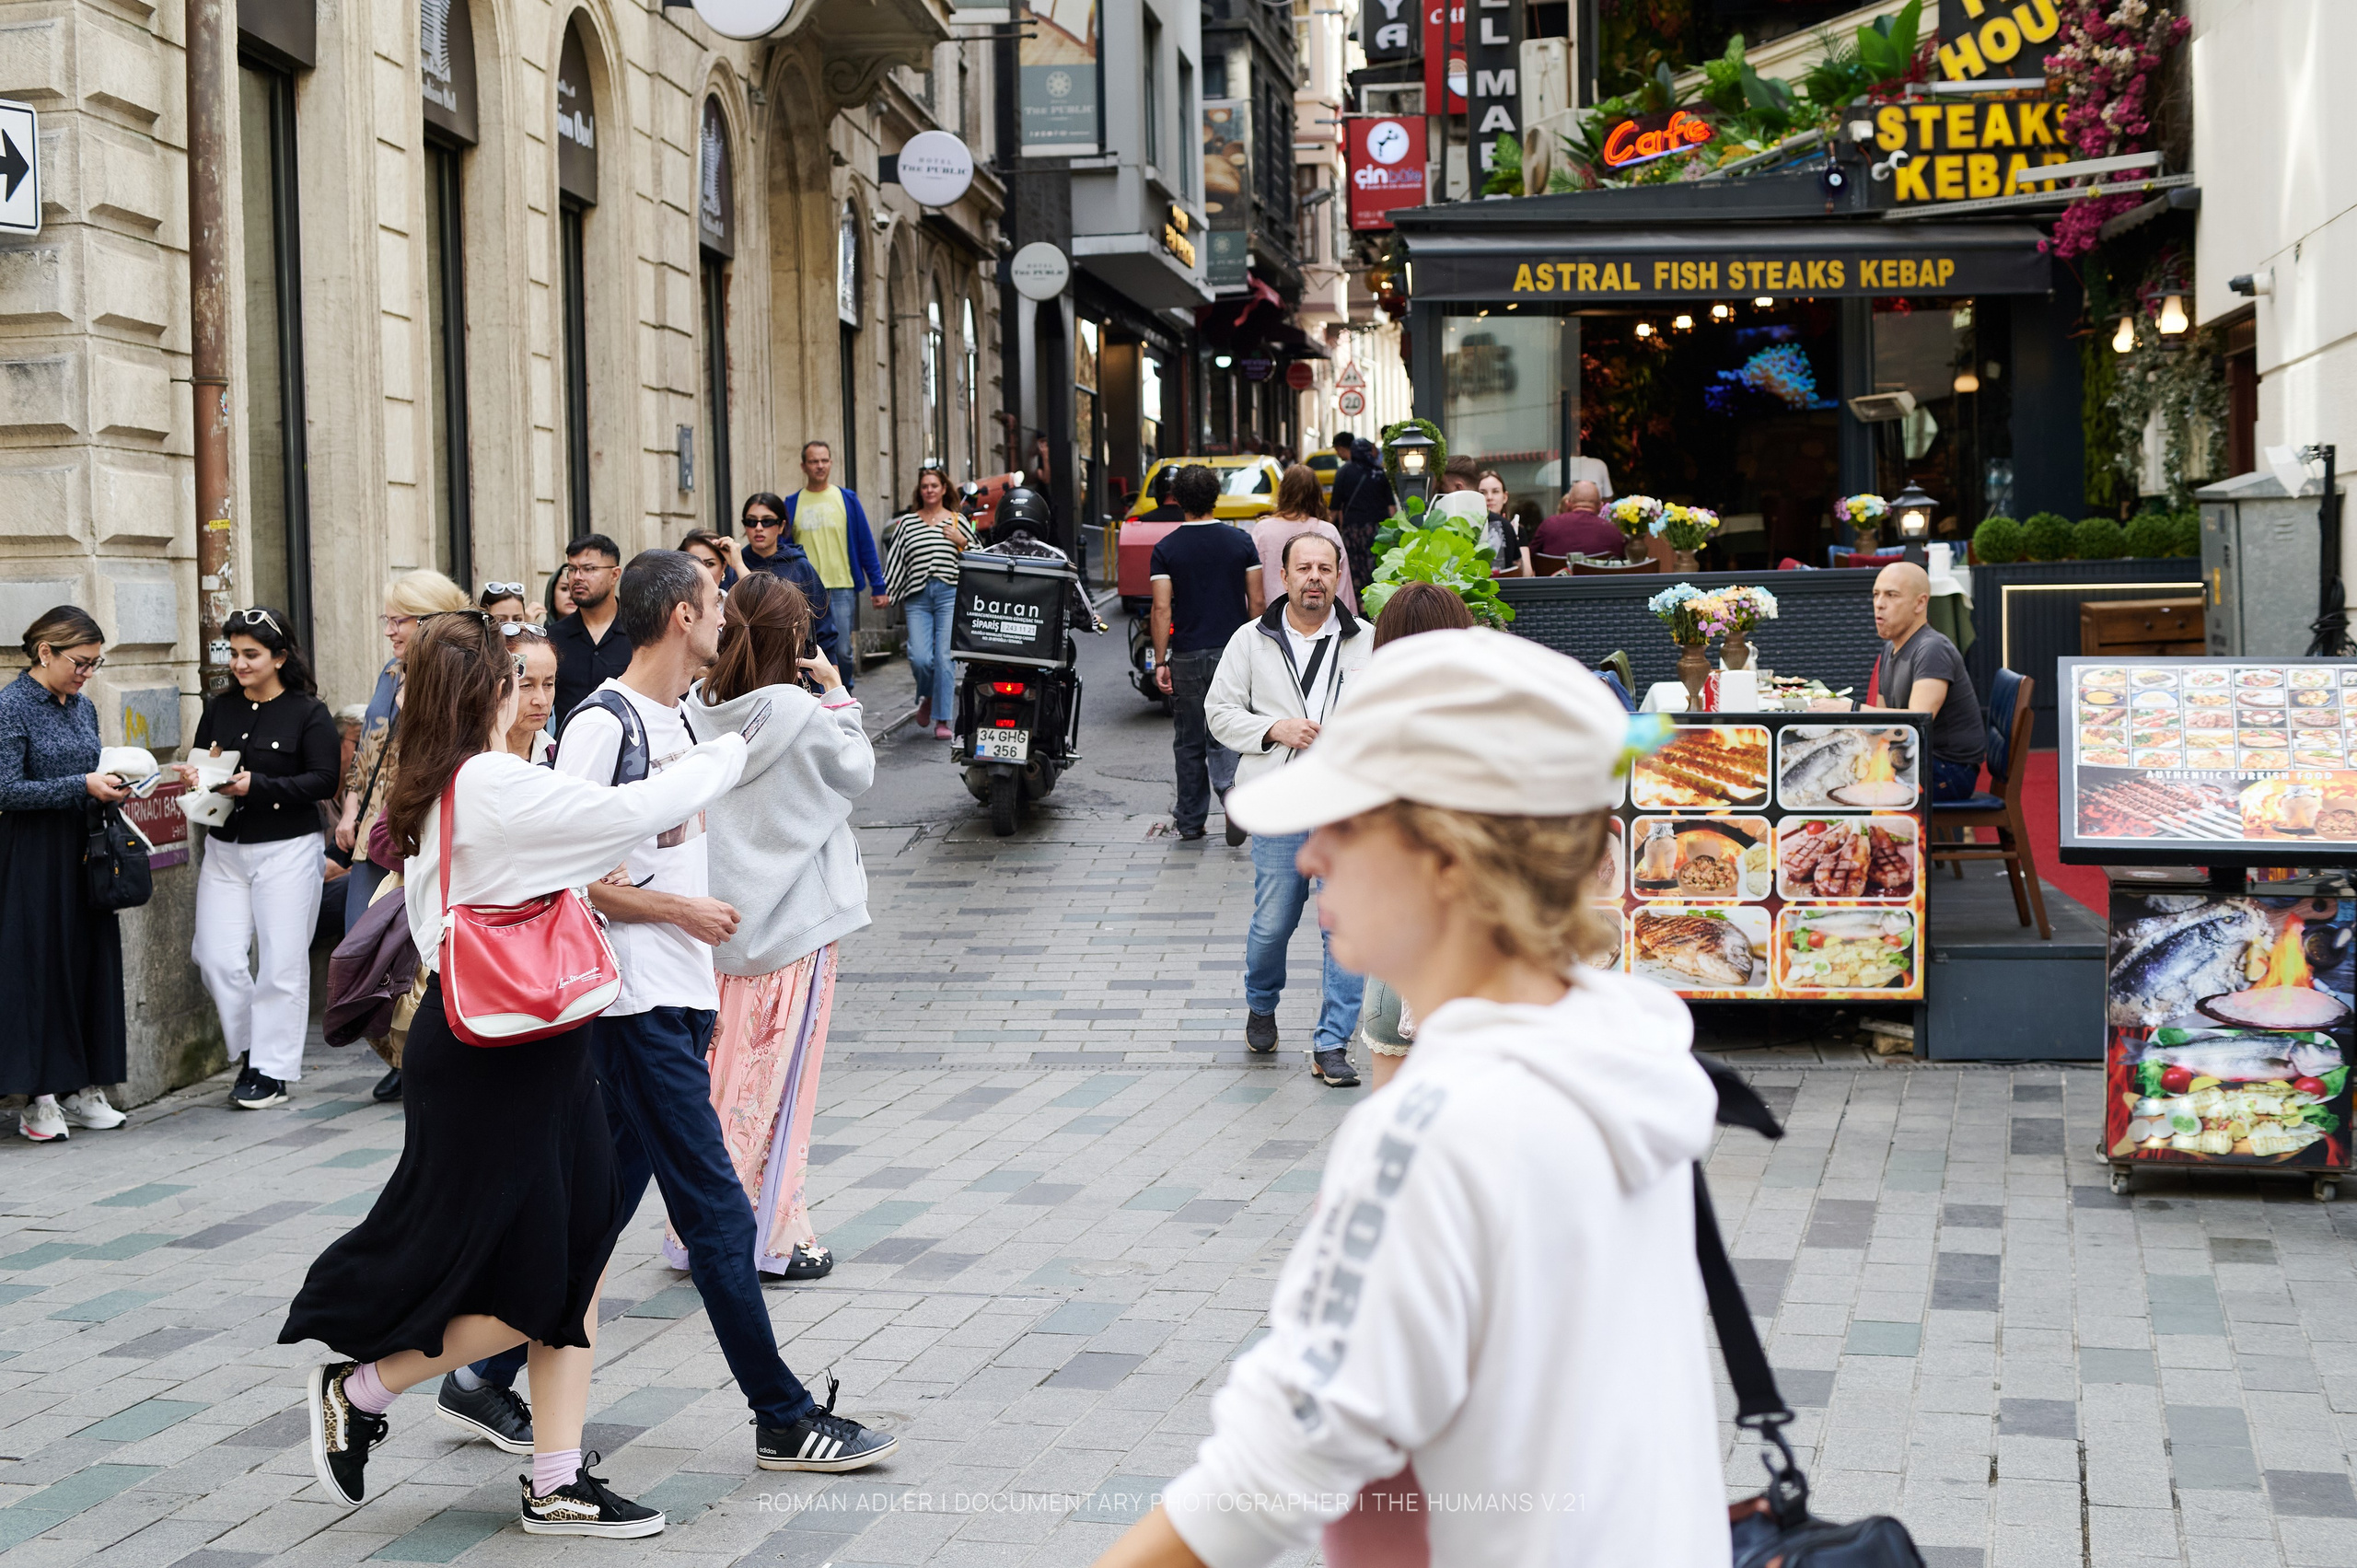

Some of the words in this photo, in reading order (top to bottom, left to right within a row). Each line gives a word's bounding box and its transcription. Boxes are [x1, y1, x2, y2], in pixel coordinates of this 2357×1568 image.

[1938, 0, 2062, 81] HOU
[1512, 262, 1641, 293] ASTRAL
[1654, 261, 1718, 290] FISH
[1727, 261, 1845, 291] STEAKS
[1859, 259, 1956, 288] KEBAP
[973, 595, 1039, 619] baran
[971, 618, 999, 633] SİPARİŞ
[1005, 624, 1017, 633] 243
[980, 730, 995, 741] 34
[998, 730, 1027, 743] GHG
[993, 745, 1017, 758] 356
[2146, 770, 2223, 781] AUTHENTIC
[2231, 771, 2290, 781] TURKISH
[2297, 772, 2334, 781] FOOD
[164, 795, 186, 819] BAŞ
[759, 1446, 777, 1455] adidas
